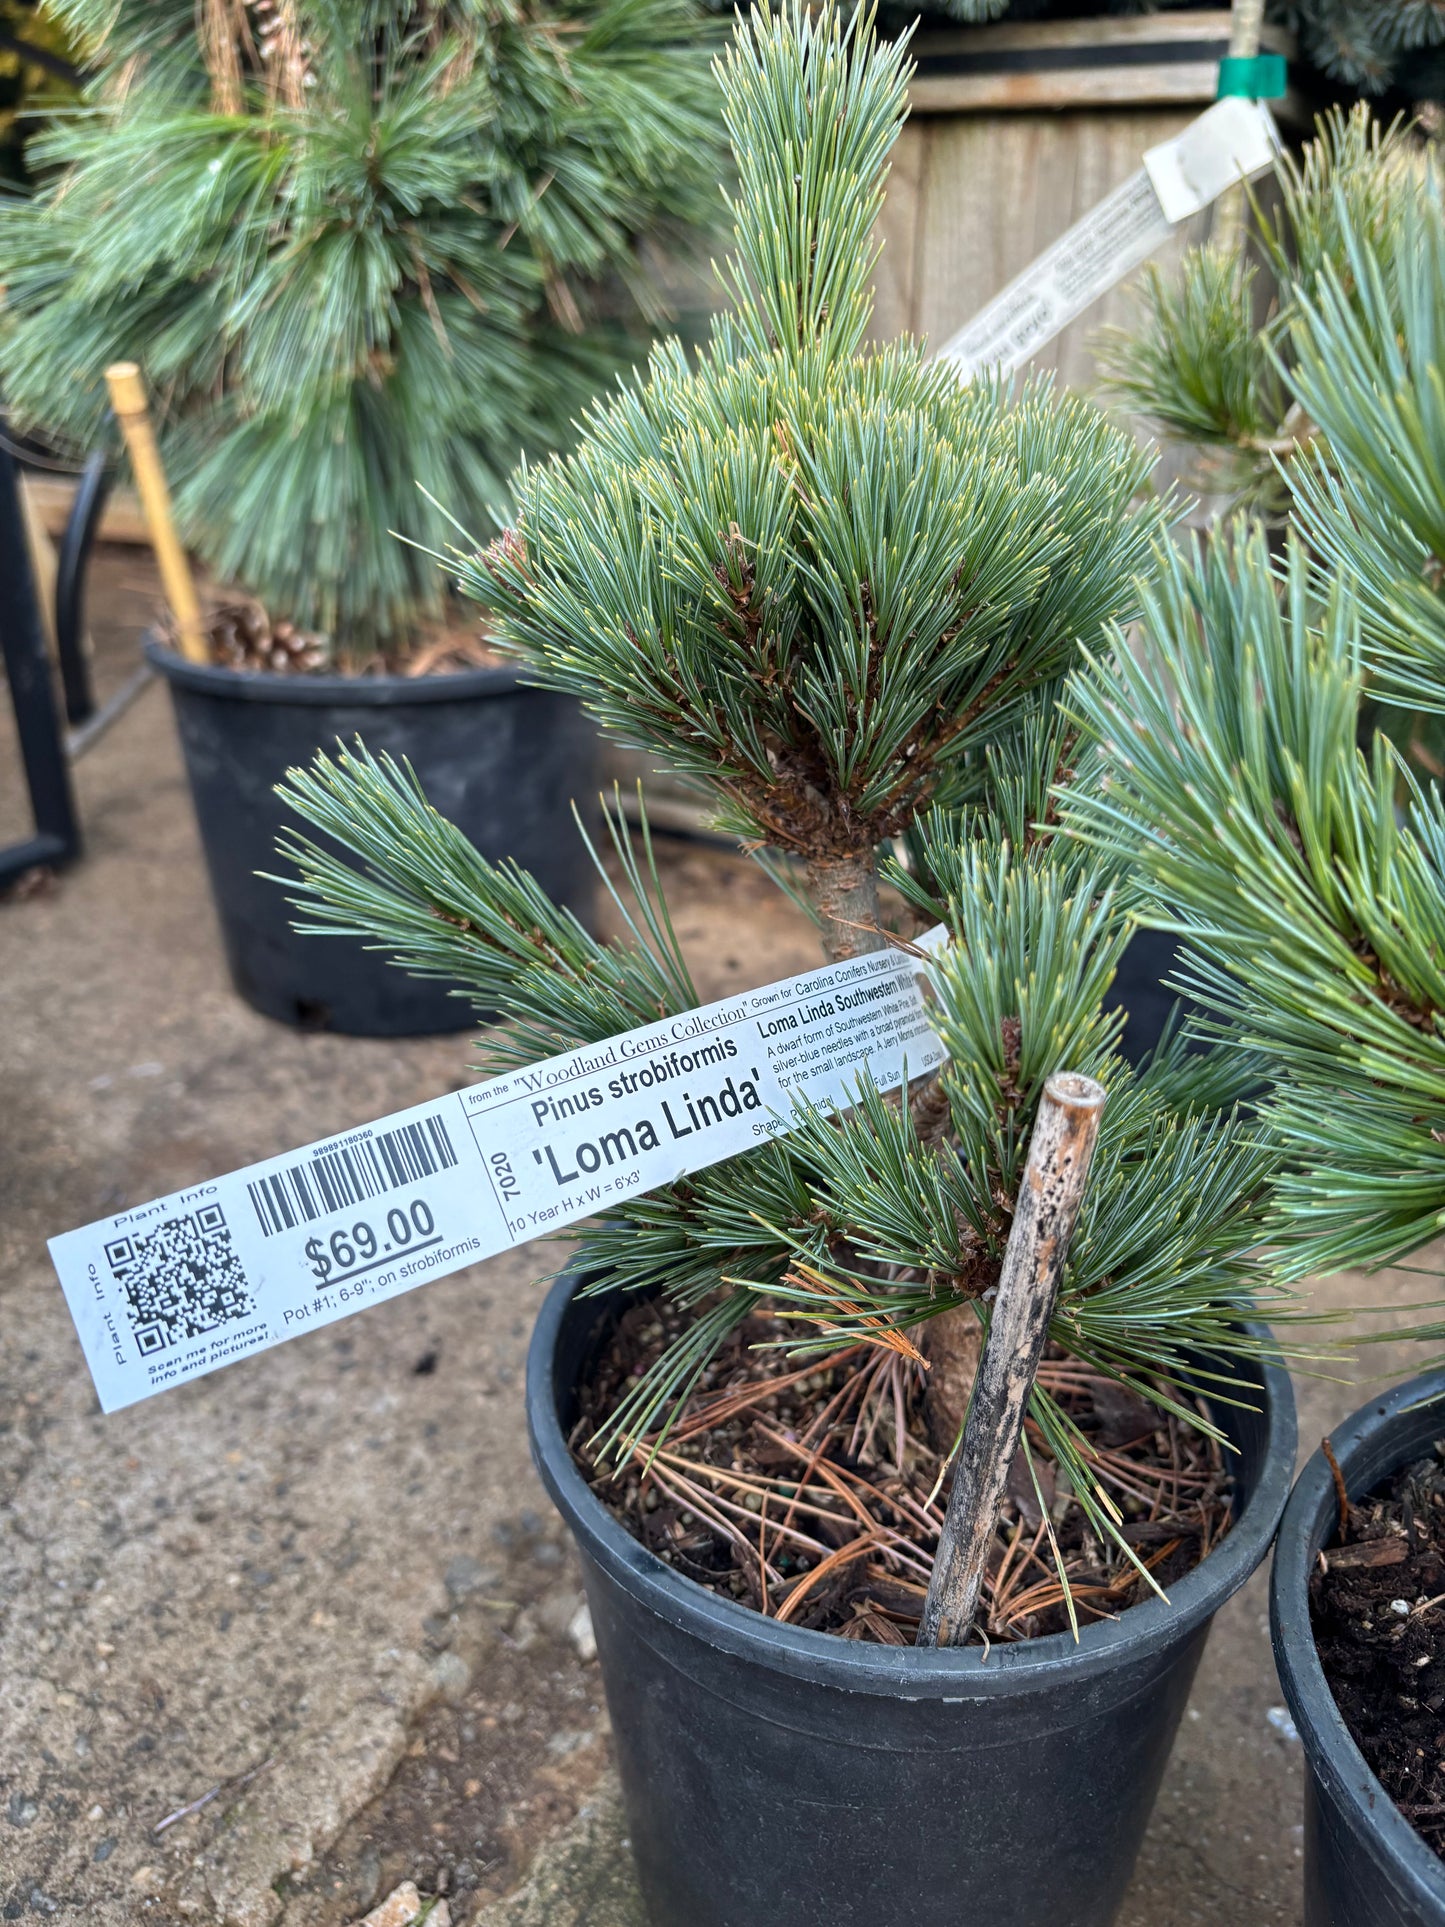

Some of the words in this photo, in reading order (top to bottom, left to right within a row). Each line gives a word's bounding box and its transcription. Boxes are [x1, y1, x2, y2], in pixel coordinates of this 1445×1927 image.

[469, 1090, 491, 1105] from
[493, 1083, 509, 1098] the
[513, 1047, 618, 1093] "Woodland
[620, 1034, 669, 1060] Gems
[671, 1001, 748, 1040] Collection"
[751, 992, 781, 1009] Grown
[780, 988, 792, 1001] for
[795, 975, 835, 996] Carolina
[835, 965, 868, 984] Conifers
[867, 958, 891, 974] Nursery
[756, 1014, 799, 1039] Loma
[797, 1000, 835, 1024] Linda
[835, 980, 898, 1012] Southwestern
[767, 1046, 776, 1059] A
[777, 1035, 803, 1055] dwarf
[803, 1030, 825, 1045] form
[825, 1024, 835, 1037] of
[834, 1009, 883, 1033] Southwestern
[772, 1047, 820, 1073] silver-blue
[821, 1036, 854, 1056] needles
[854, 1029, 870, 1044] with
[869, 1028, 876, 1038] a
[875, 1018, 894, 1035] broad
[777, 1076, 791, 1089] for
[792, 1070, 809, 1083] the
[811, 1059, 835, 1077] small
[834, 1045, 876, 1068] landscape.
[876, 1040, 884, 1052] A
[883, 1035, 899, 1051] Jerry
[531, 1087, 604, 1128] Pinus
[608, 1037, 738, 1099] strobiformis
[874, 1074, 887, 1087] Full
[887, 1070, 901, 1082] Sun
[532, 1119, 661, 1186] 'Loma
[660, 1067, 762, 1140] Linda'
[490, 1152, 521, 1203] 7020
[509, 1219, 527, 1234] 10
[528, 1203, 560, 1225] Year
[563, 1199, 575, 1214] H
[577, 1196, 585, 1207] x
[585, 1189, 602, 1206] W
[604, 1183, 613, 1192] =
[614, 1170, 641, 1190] 6'x3'
[113, 1202, 168, 1229] Plant
[180, 1186, 218, 1204] Info
[304, 1199, 436, 1284] $69.00
[87, 1263, 105, 1300] Info
[283, 1306, 311, 1325] Pot
[313, 1295, 337, 1313] #1;
[377, 1271, 399, 1286] on
[400, 1236, 481, 1278] strobiformis
[103, 1311, 127, 1366] Plant
[148, 1357, 182, 1374] Scan
[186, 1347, 206, 1359] me
[210, 1337, 230, 1349] for
[233, 1323, 267, 1341] more
[182, 1356, 206, 1372] and
[210, 1331, 269, 1363] pictures!
